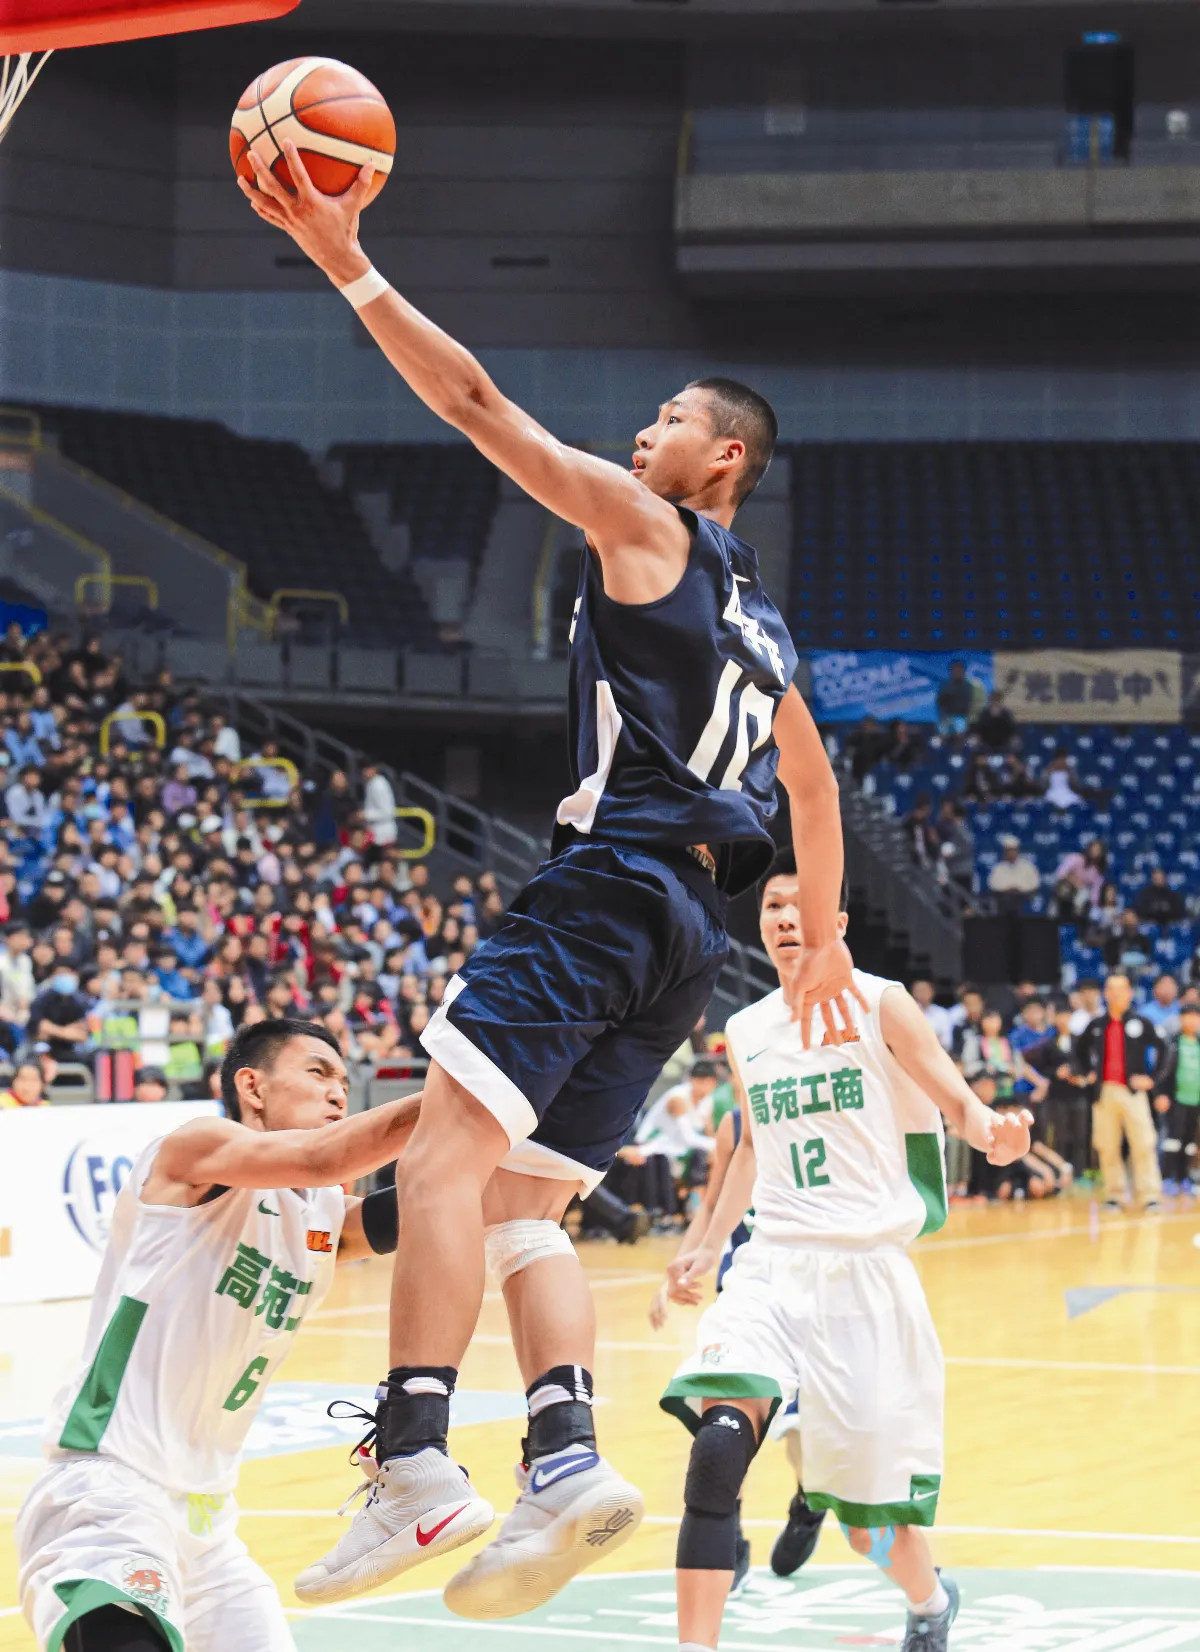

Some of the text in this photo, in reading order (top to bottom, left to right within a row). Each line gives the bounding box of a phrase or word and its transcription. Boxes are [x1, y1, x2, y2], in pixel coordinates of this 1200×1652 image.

[748, 1067, 864, 1127] 高苑工商
[790, 1137, 830, 1189] 12
[222, 1355, 269, 1412] 6
